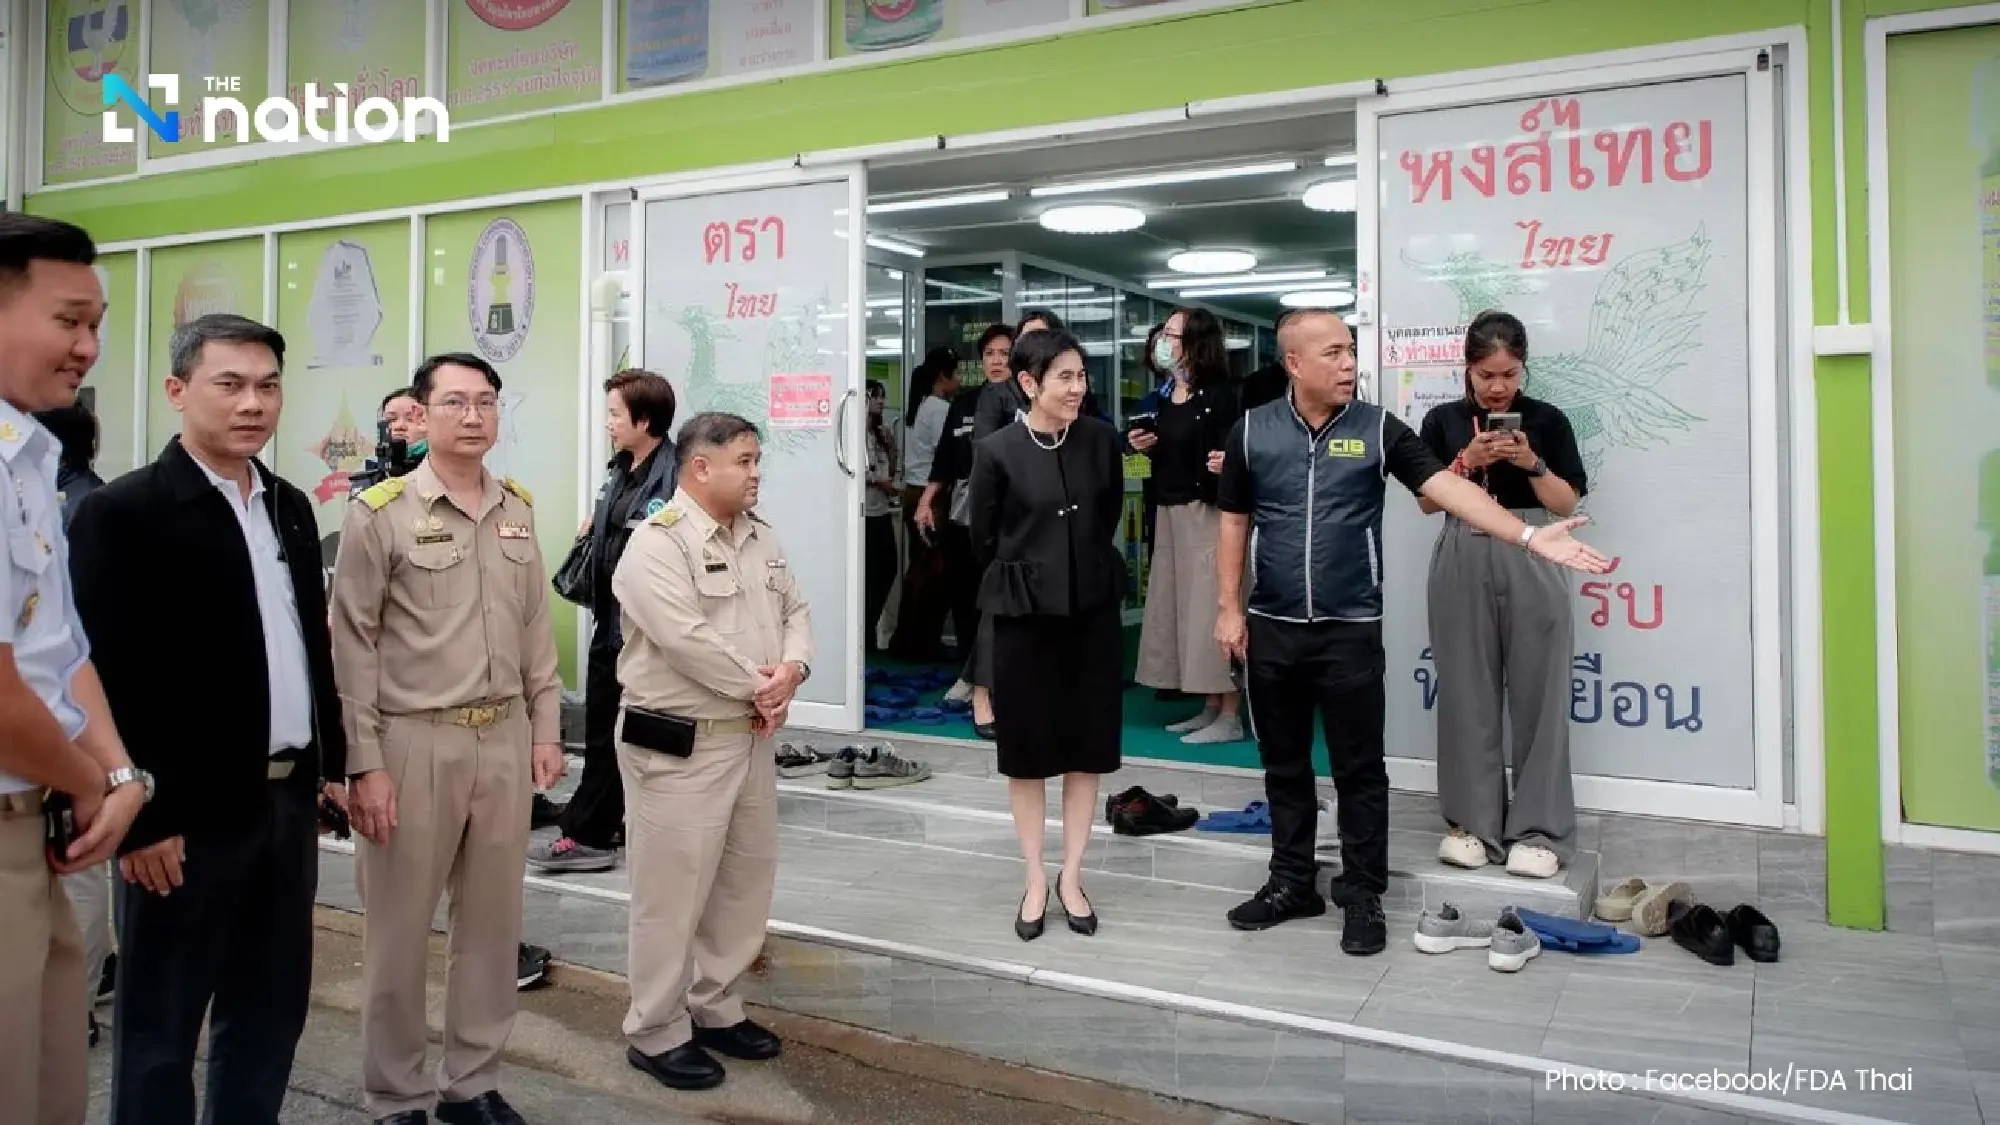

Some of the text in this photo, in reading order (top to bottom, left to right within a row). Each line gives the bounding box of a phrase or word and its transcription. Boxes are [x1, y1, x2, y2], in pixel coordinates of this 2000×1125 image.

[1399, 97, 1713, 204] หงส์ไทย
[703, 214, 786, 264] ตรา
[1516, 219, 1614, 269] ไทย
[724, 283, 778, 319] ไทย
[1328, 439, 1366, 453] CIB
